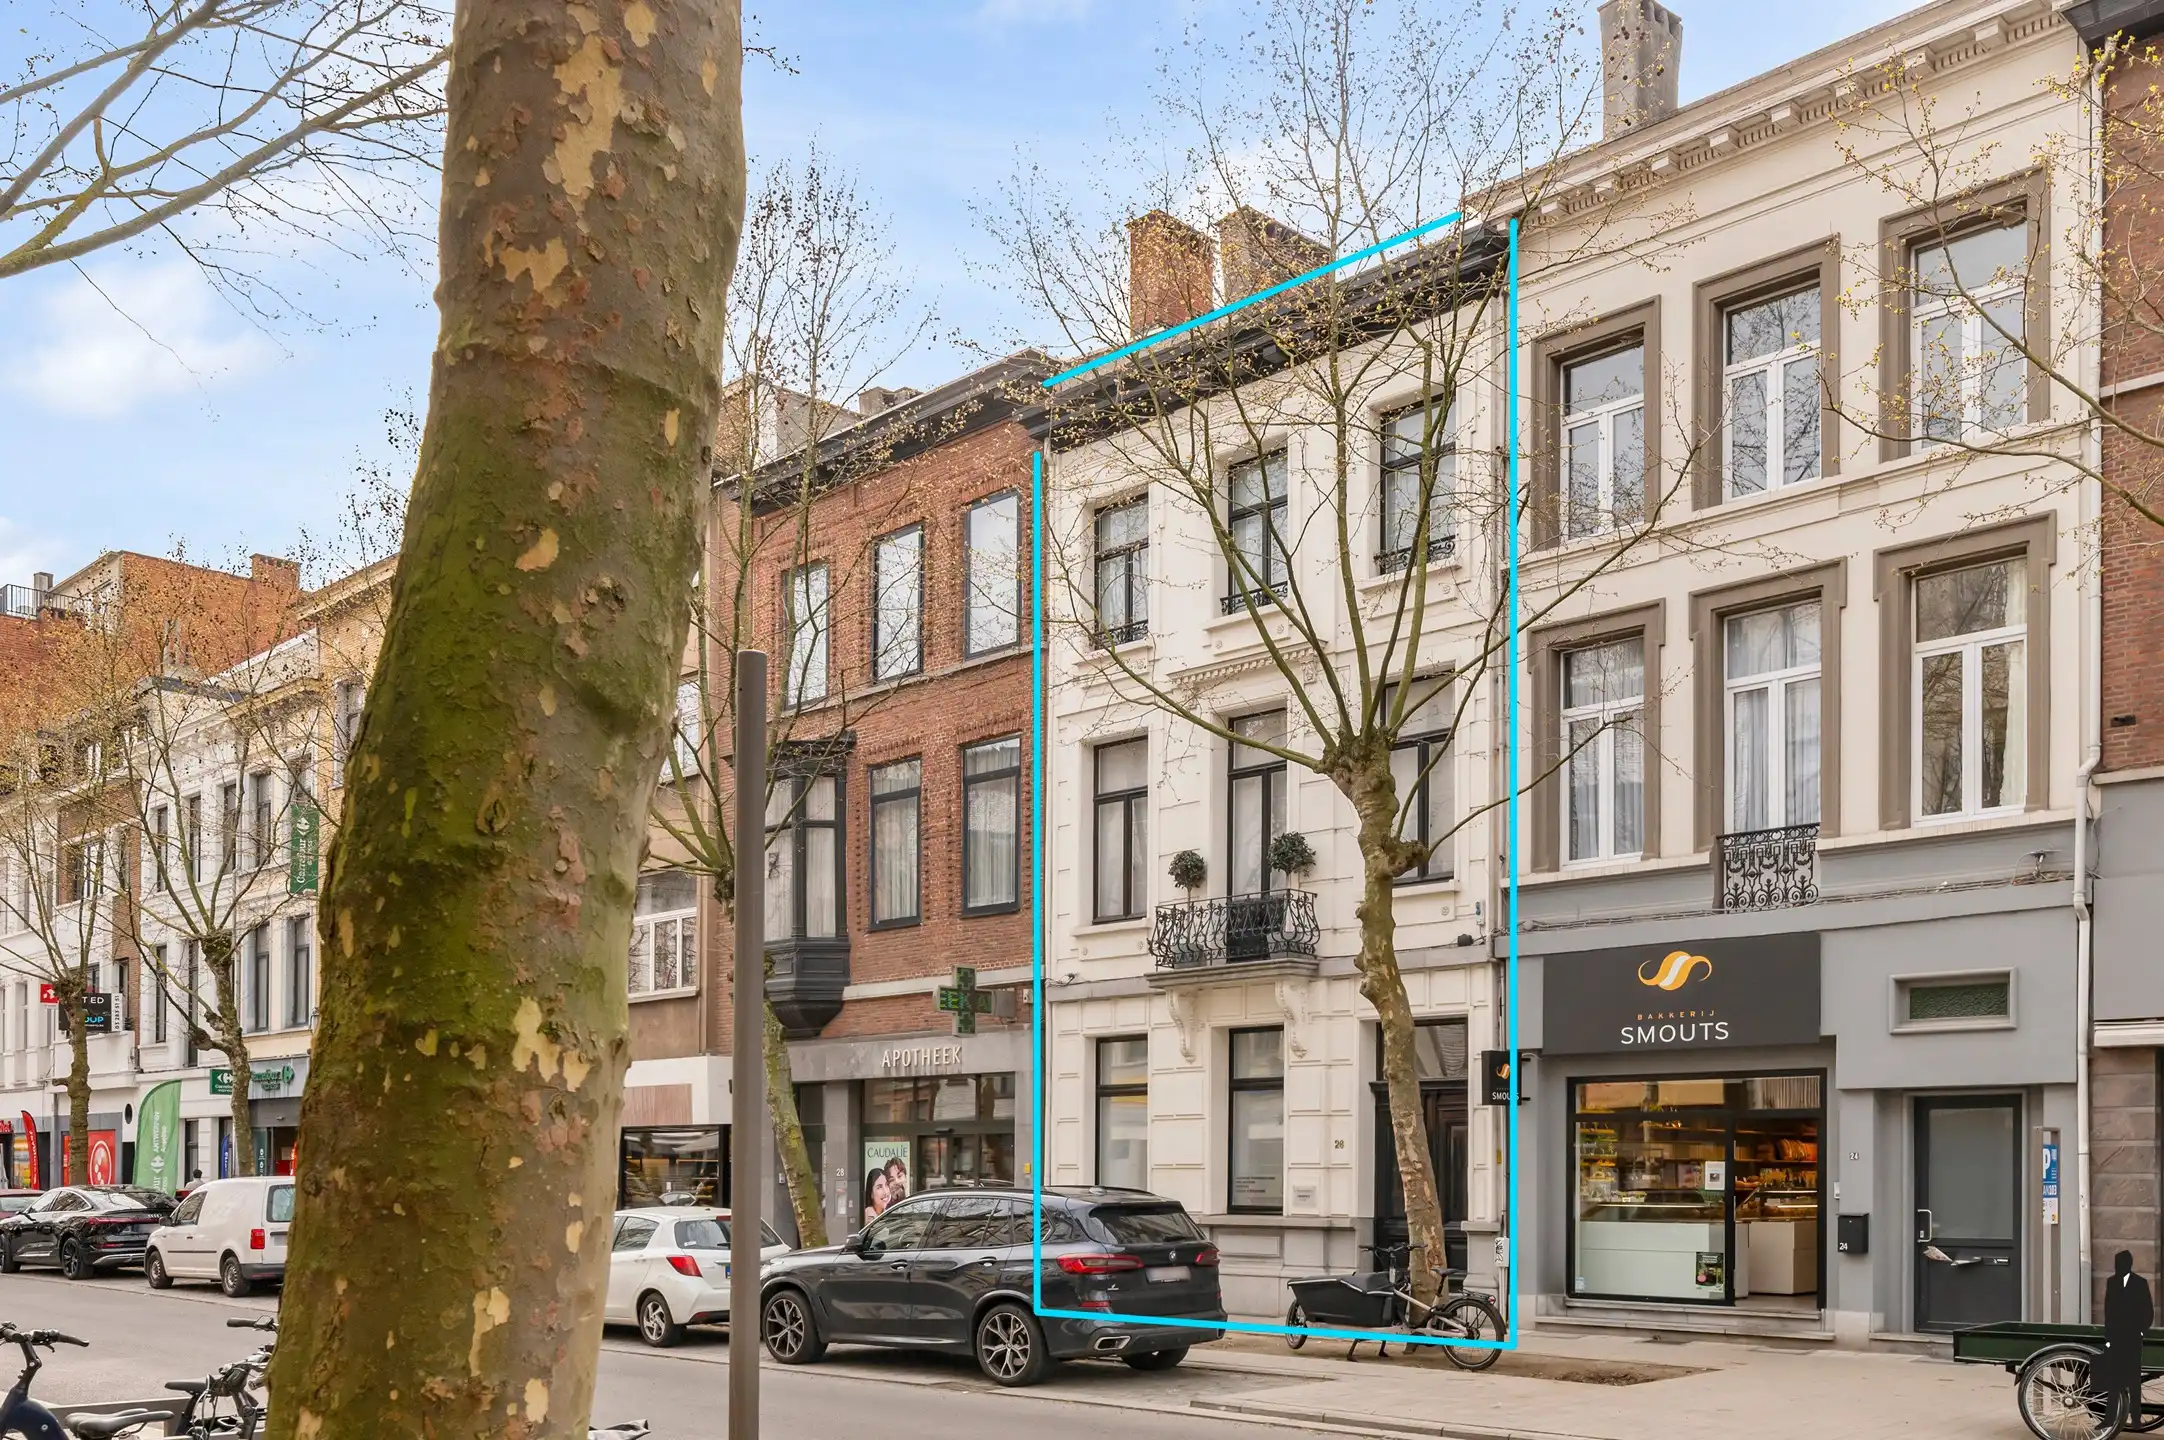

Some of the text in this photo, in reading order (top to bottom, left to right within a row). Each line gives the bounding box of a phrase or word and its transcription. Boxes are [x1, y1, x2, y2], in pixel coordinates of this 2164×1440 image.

[296, 838, 306, 884] Carrefour
[1637, 1009, 1716, 1021] BAKKERIJ
[1620, 1021, 1729, 1045] SMOUTS
[881, 1044, 961, 1068] APOTHEEK
[1492, 1091, 1520, 1101] SMOUS
[1849, 1151, 1859, 1160] 24
[2042, 1148, 2051, 1179] P
[1839, 1242, 1848, 1250] 24
